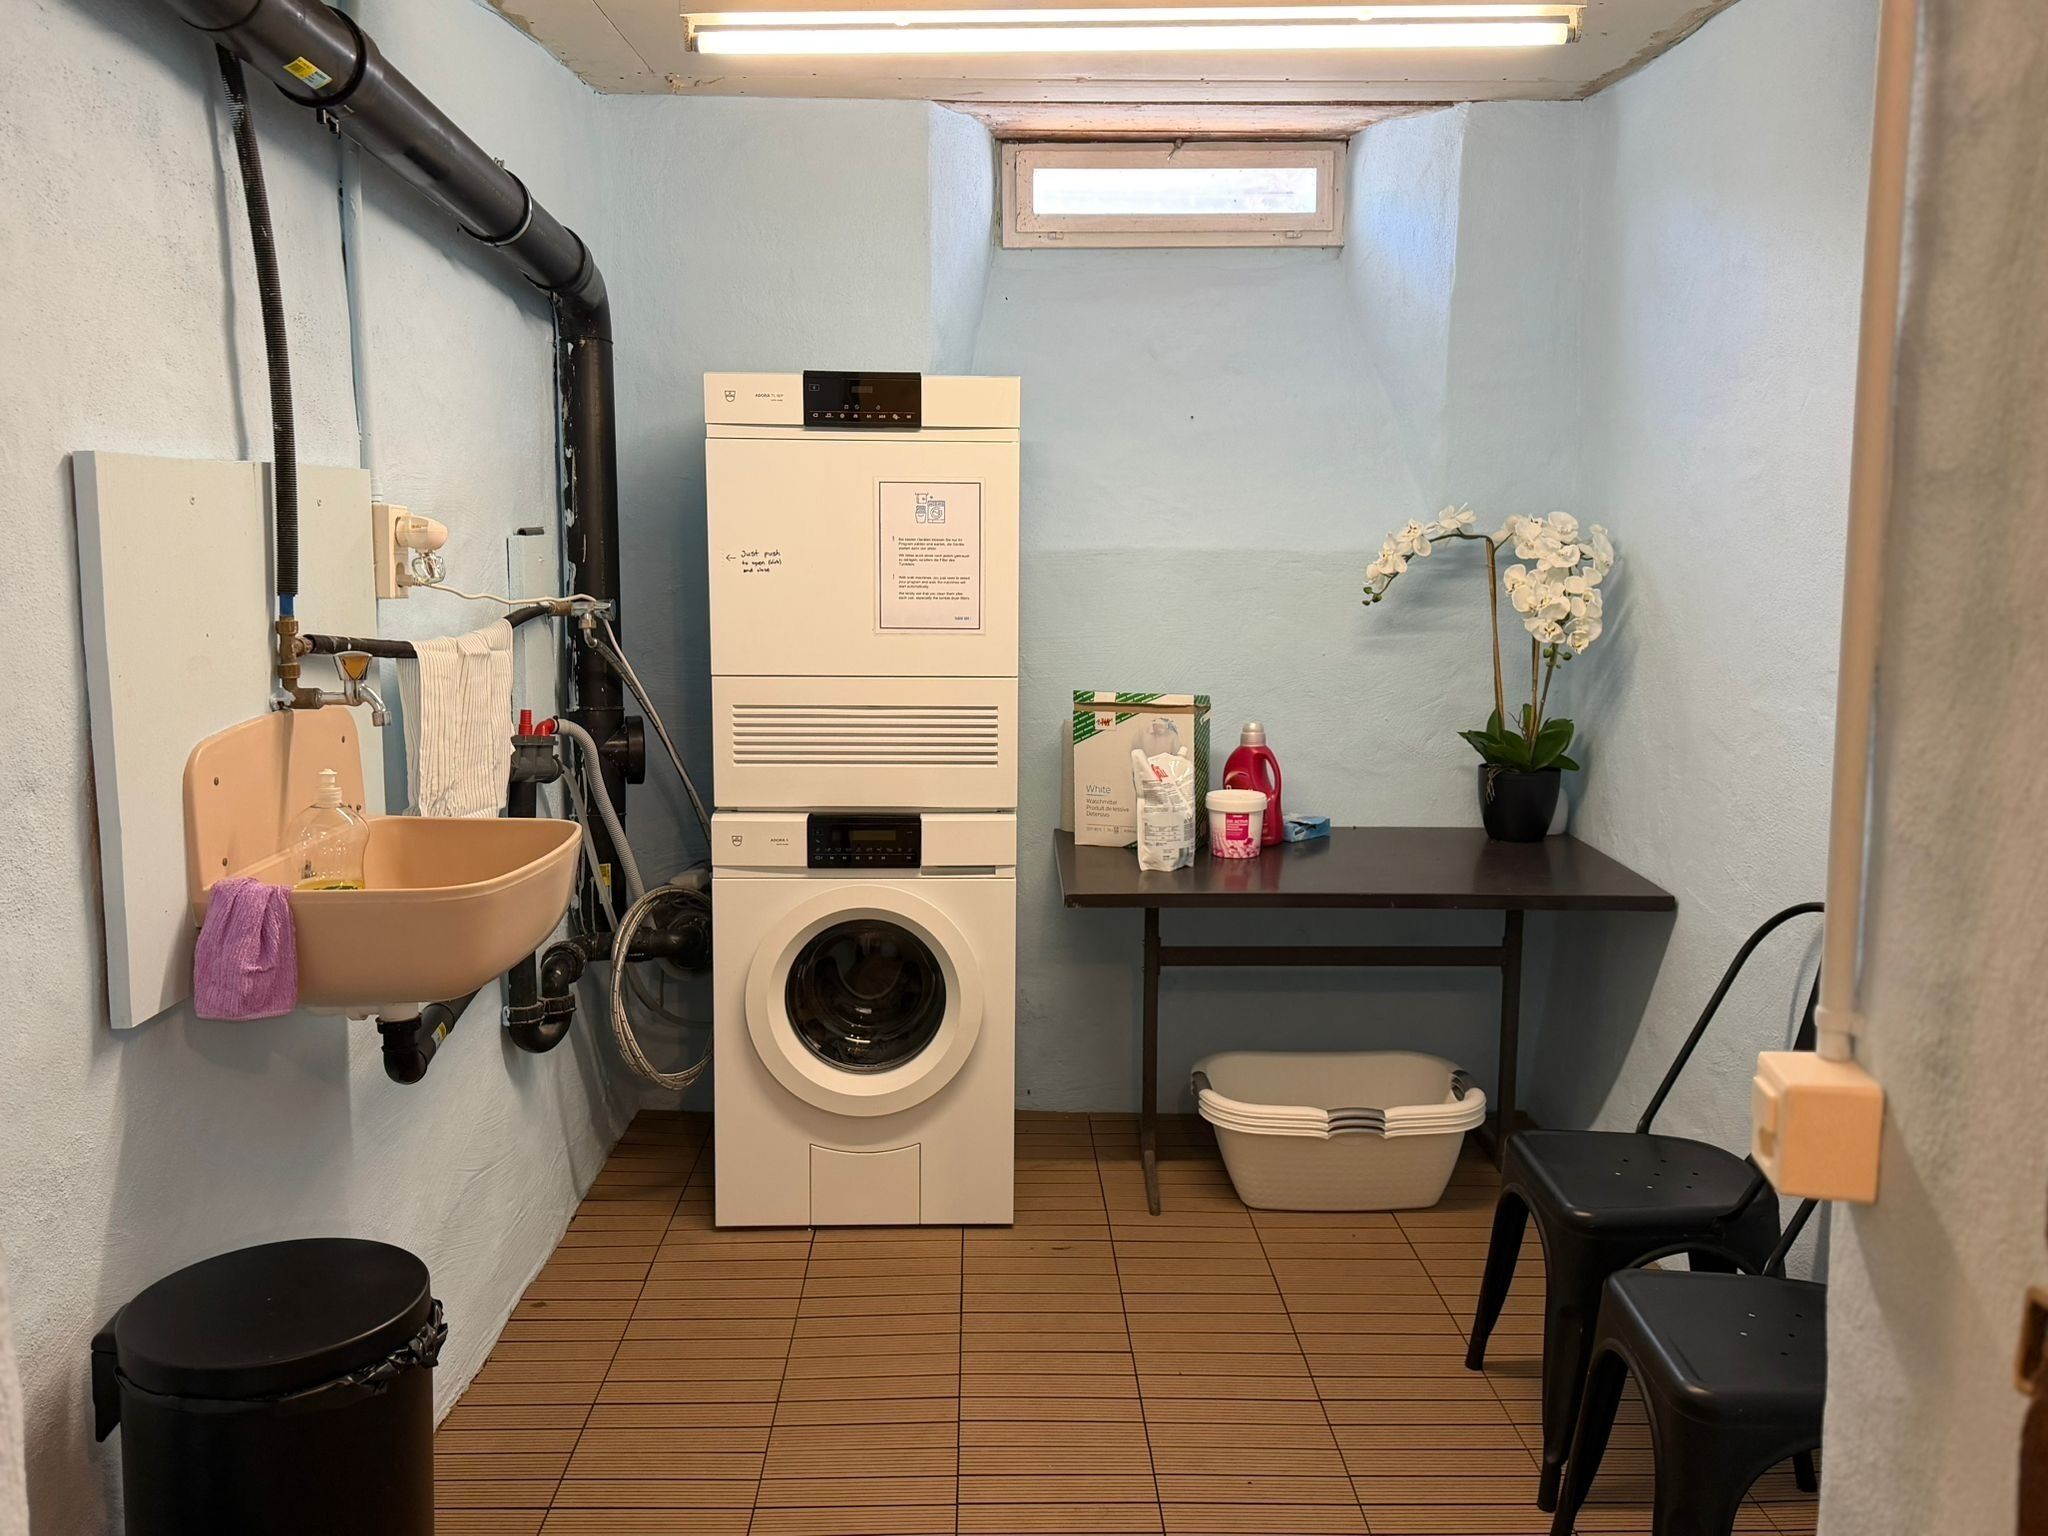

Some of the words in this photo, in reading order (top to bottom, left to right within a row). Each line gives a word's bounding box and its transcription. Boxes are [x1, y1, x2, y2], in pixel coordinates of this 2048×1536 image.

[741, 549, 759, 558] Just
[764, 549, 781, 558] push
[1086, 784, 1111, 794] White
